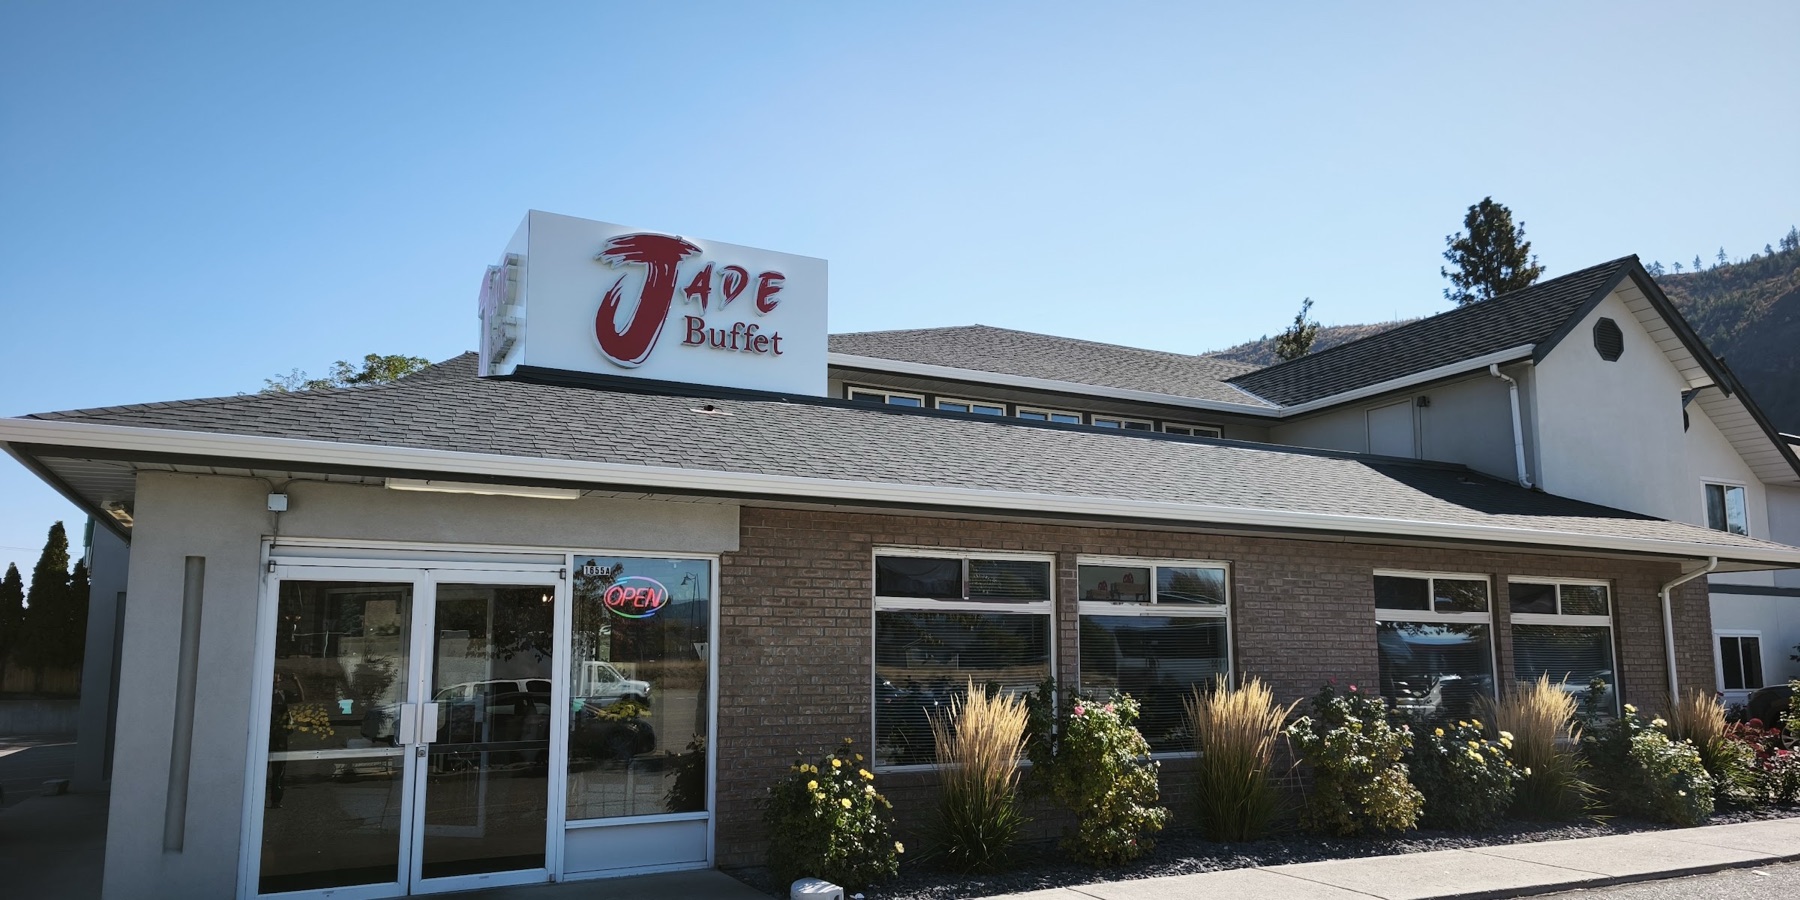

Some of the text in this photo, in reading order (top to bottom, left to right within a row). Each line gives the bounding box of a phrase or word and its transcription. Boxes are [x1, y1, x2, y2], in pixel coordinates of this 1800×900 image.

[683, 315, 783, 357] Buffet
[585, 566, 610, 575] 1655A
[608, 587, 662, 608] OPEN
